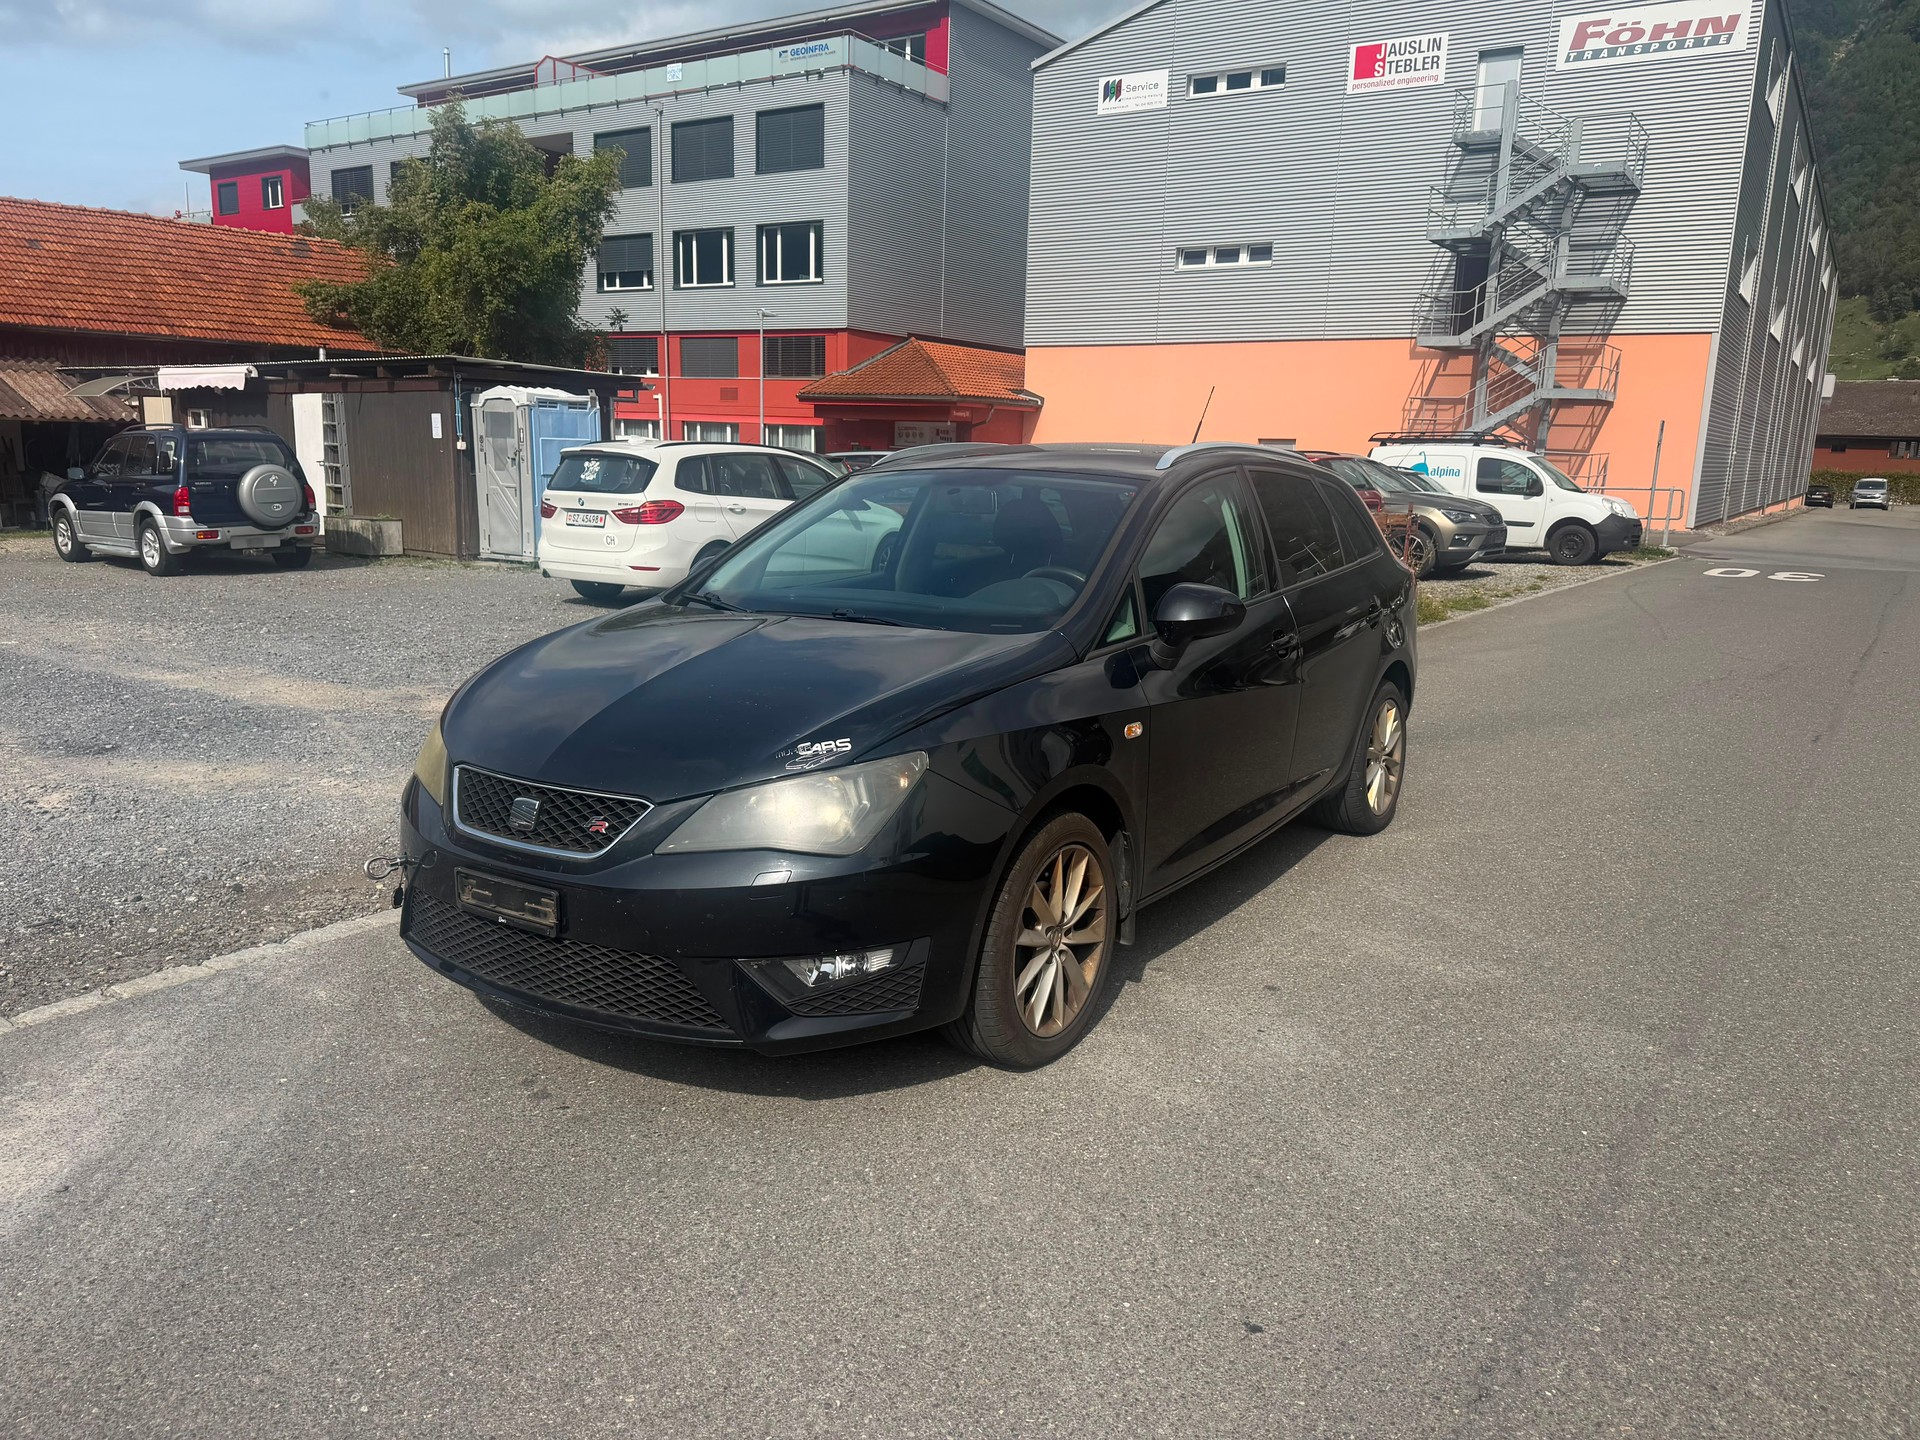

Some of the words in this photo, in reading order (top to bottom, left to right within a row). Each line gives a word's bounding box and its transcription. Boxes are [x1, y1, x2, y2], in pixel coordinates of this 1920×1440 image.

[1568, 14, 1741, 51] FÖHN
[790, 43, 830, 57] GEOINFRA
[1376, 37, 1442, 60] JAUSLIN
[1568, 33, 1730, 62] TRANSPORTE
[1373, 55, 1440, 77] STEBLER
[1351, 78, 1396, 91] personalized
[1396, 74, 1439, 86] engineering
[1430, 466, 1461, 478] alpina
[605, 535, 616, 546] CH
